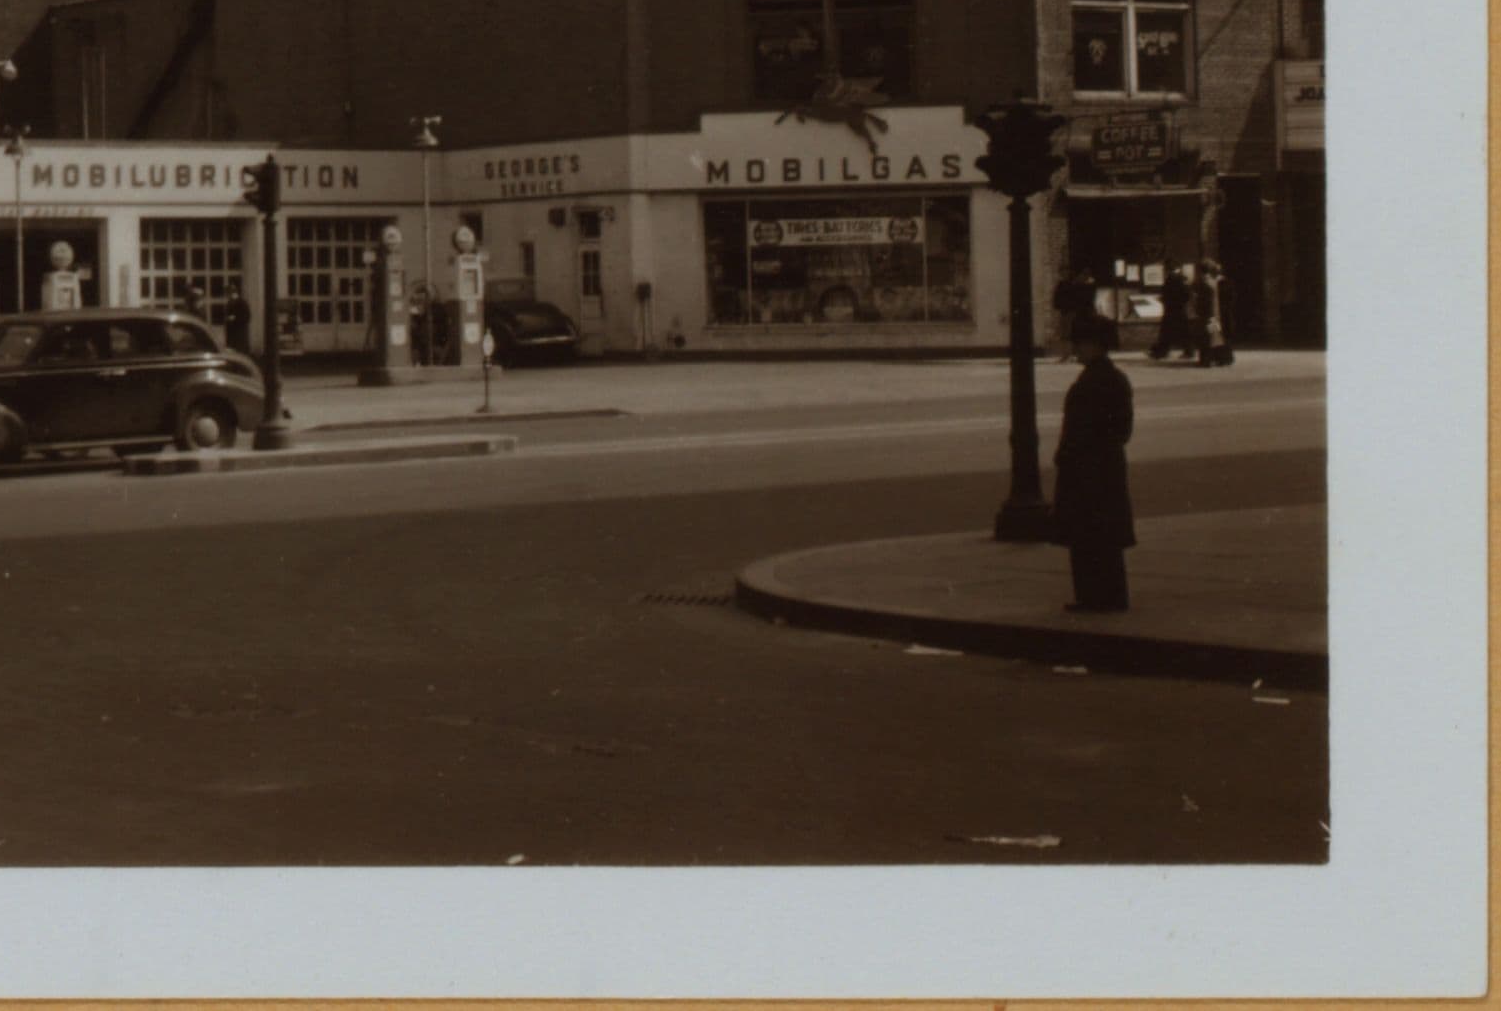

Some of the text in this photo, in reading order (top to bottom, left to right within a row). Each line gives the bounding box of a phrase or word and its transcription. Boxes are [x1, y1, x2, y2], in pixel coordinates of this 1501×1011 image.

[1101, 125, 1159, 143] COFFEE
[32, 162, 359, 189] MOBILUBRITION
[706, 154, 962, 185] MOBILGAS
